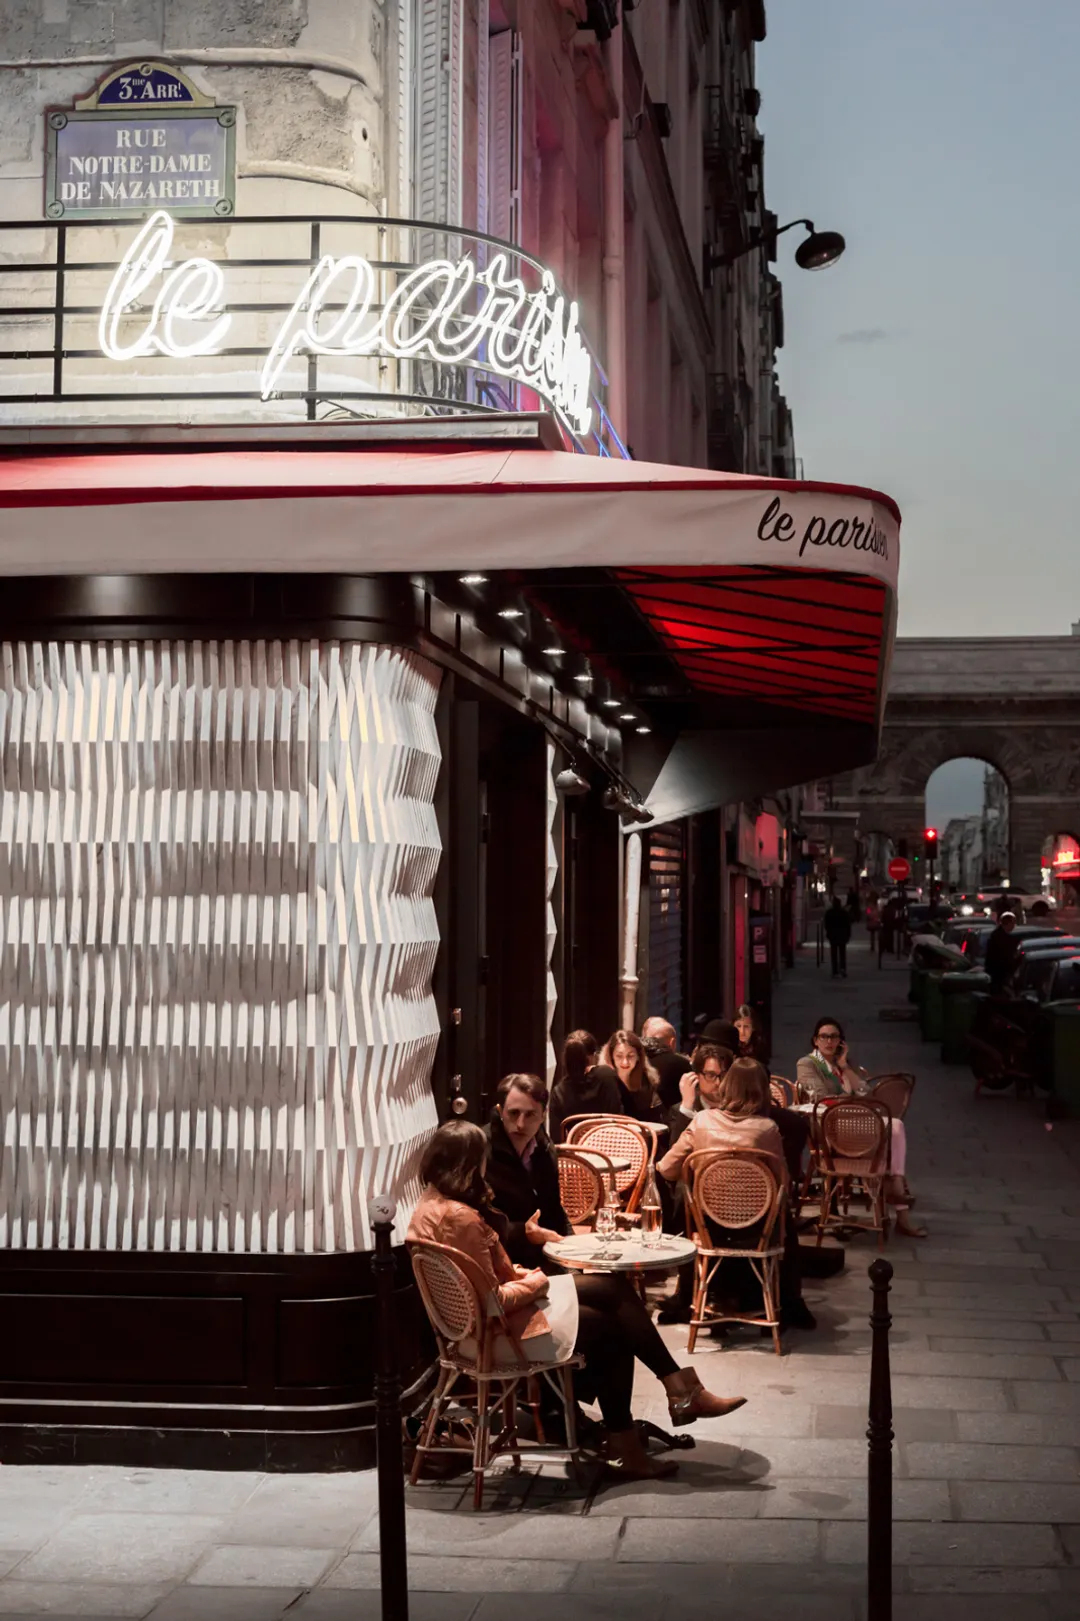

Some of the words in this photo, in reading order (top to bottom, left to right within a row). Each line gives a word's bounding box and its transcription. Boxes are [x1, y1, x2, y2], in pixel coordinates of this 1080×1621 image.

[116, 129, 167, 148] RUE
[68, 154, 212, 175] NOTRE-DAME
[61, 181, 92, 200] DE
[98, 179, 221, 199] NAZARETH
[99, 210, 232, 361] le
[757, 496, 796, 542] le
